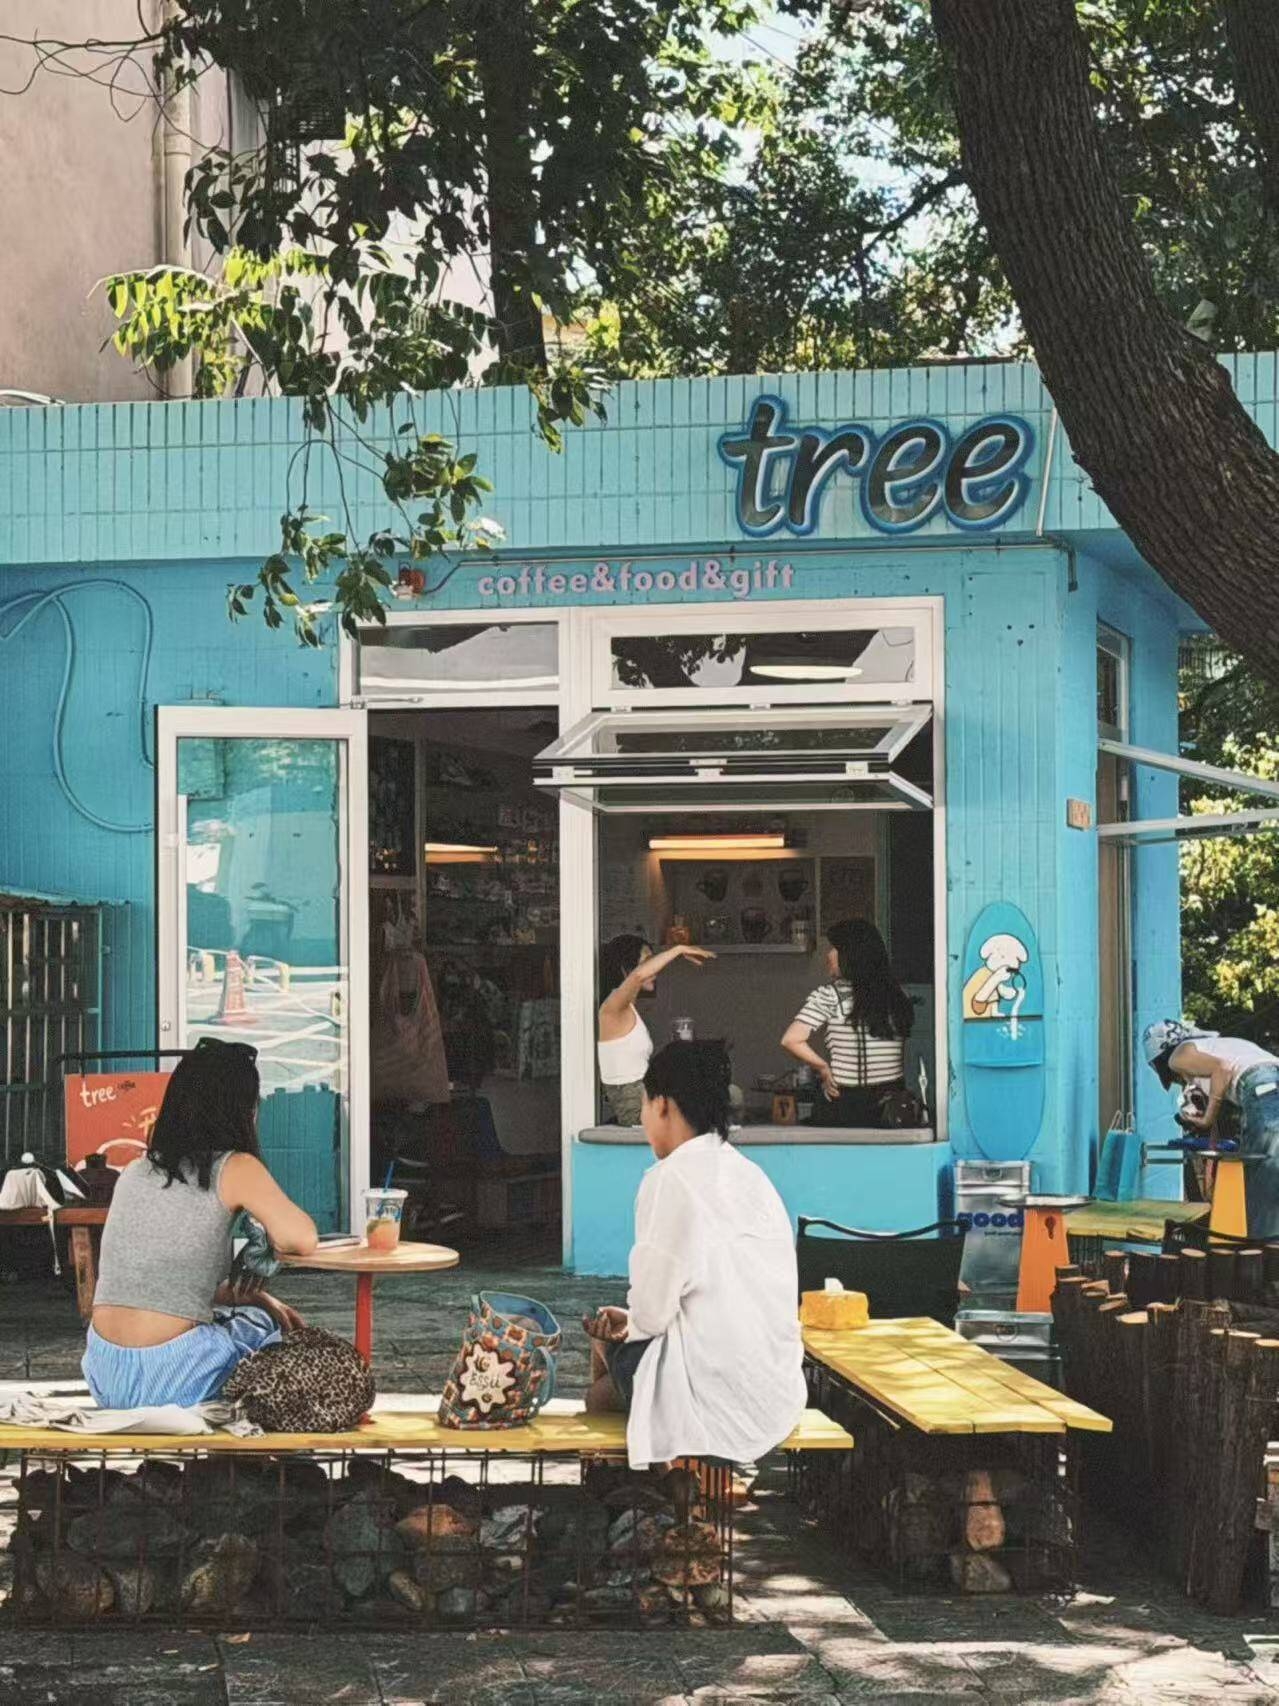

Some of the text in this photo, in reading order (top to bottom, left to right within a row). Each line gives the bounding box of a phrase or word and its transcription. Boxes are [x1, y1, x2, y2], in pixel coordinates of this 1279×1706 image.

[718, 395, 1034, 538] tree
[477, 558, 795, 600] coffee&food&gift
[80, 1081, 117, 1107] tree
